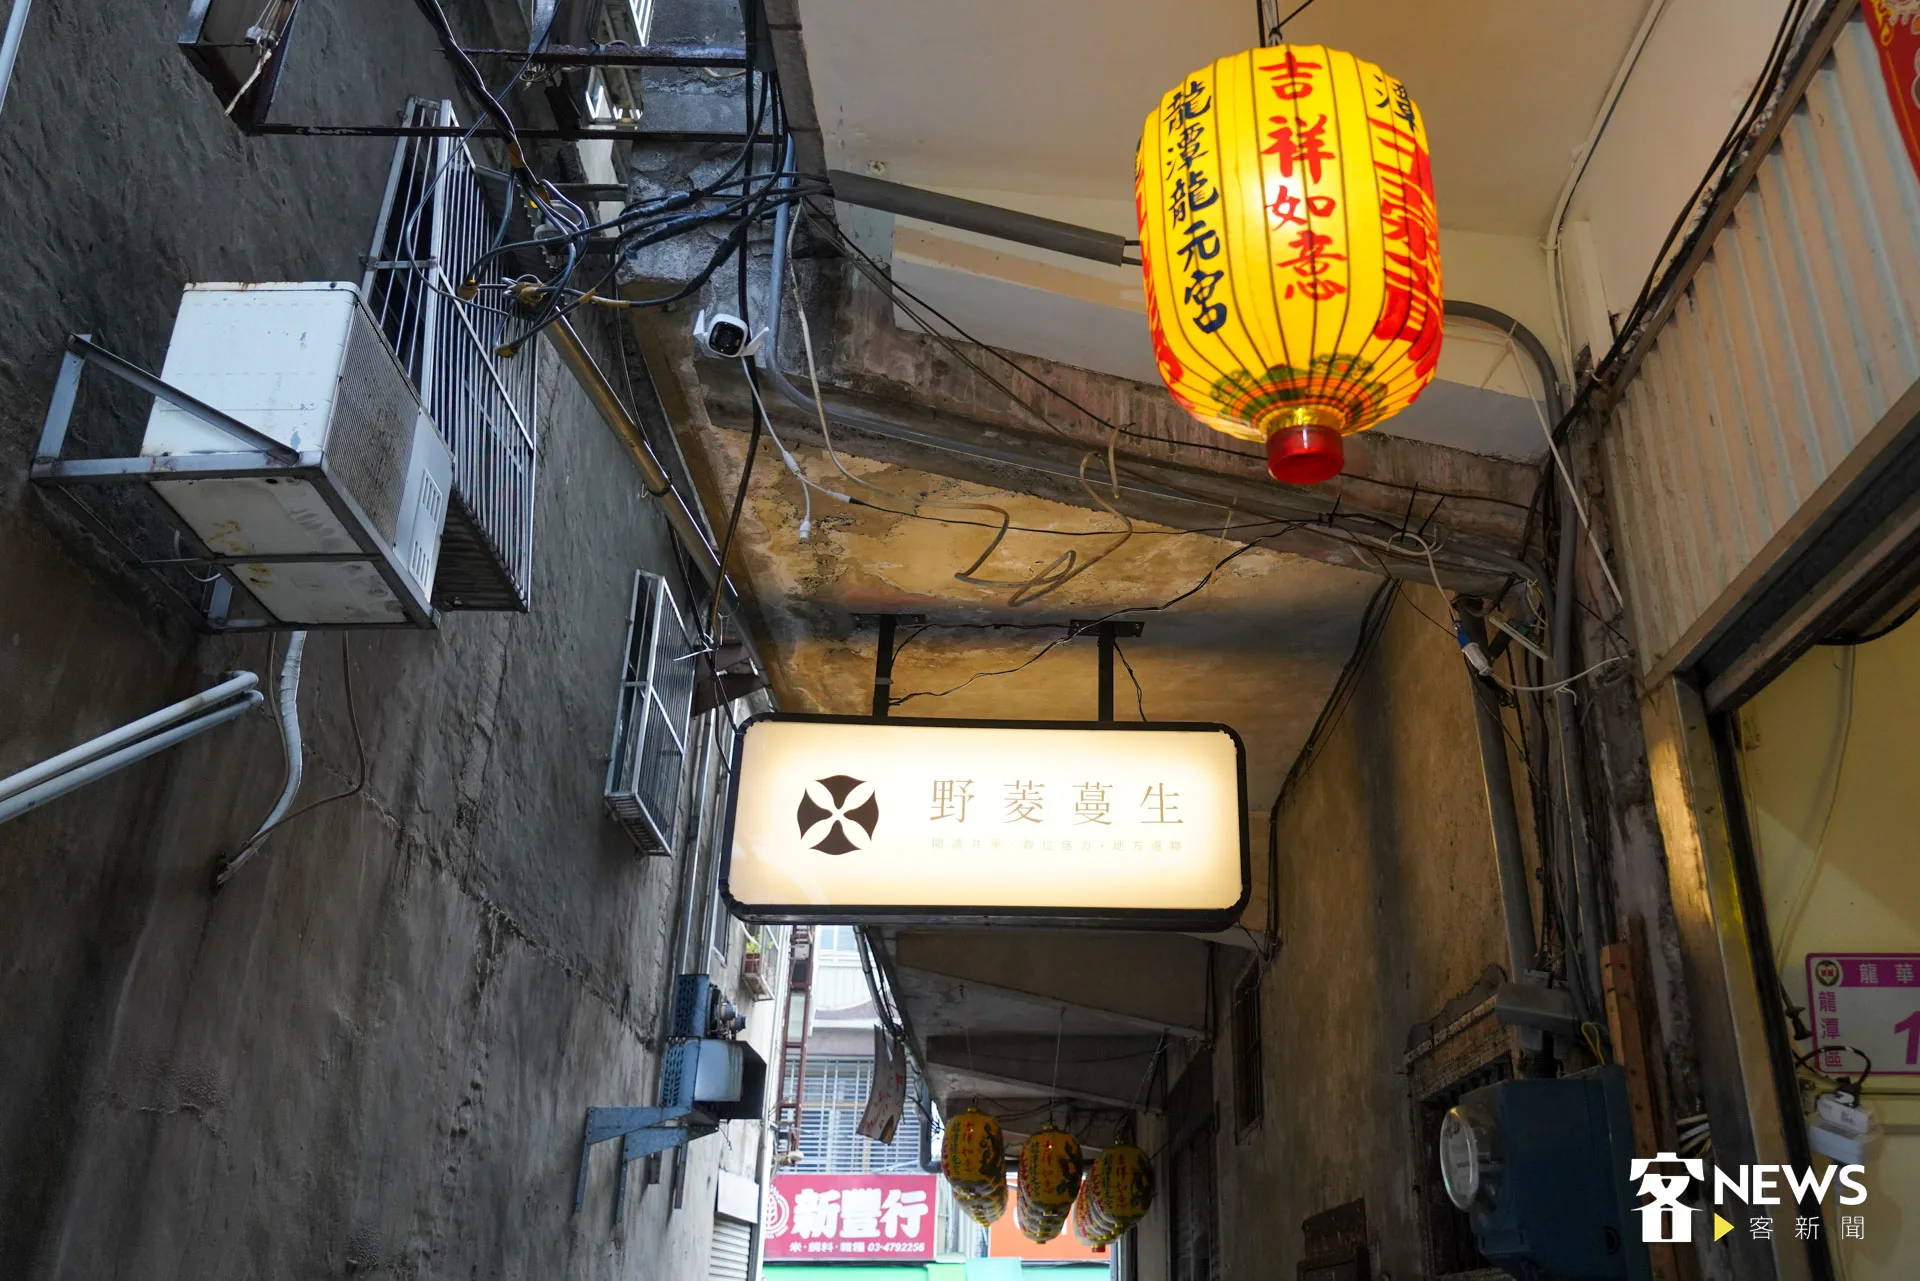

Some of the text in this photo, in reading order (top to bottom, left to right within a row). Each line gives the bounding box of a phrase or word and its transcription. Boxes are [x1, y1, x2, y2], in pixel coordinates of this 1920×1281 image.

[1163, 80, 1227, 334] 龍潭龍元宮
[1258, 51, 1348, 301] 吉祥如意
[930, 778, 1184, 826] 野菱蔓生
[791, 1187, 929, 1239] 新豐行
